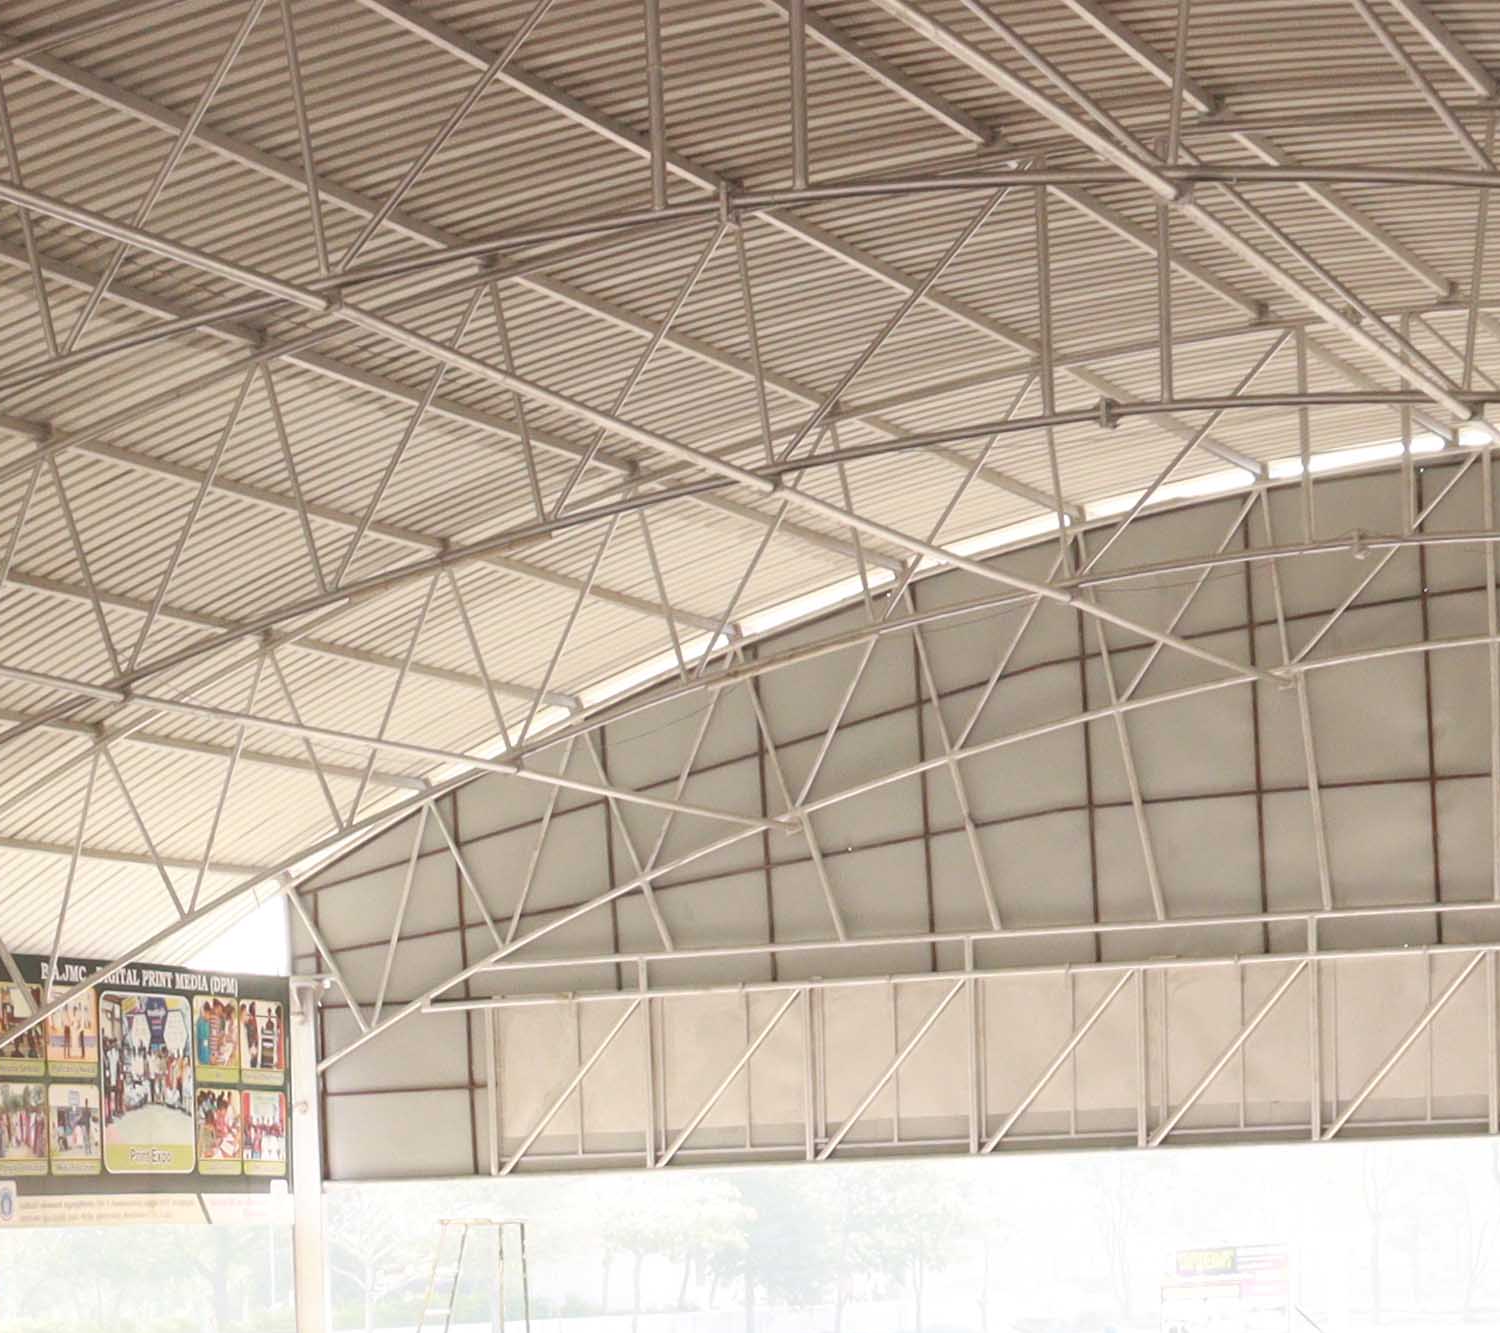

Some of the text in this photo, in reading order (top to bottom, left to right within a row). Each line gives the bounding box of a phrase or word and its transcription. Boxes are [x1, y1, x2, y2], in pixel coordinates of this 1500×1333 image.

[142, 970, 174, 989] PRINT
[175, 973, 209, 993] MEDIA
[209, 974, 239, 998] (DPM)
